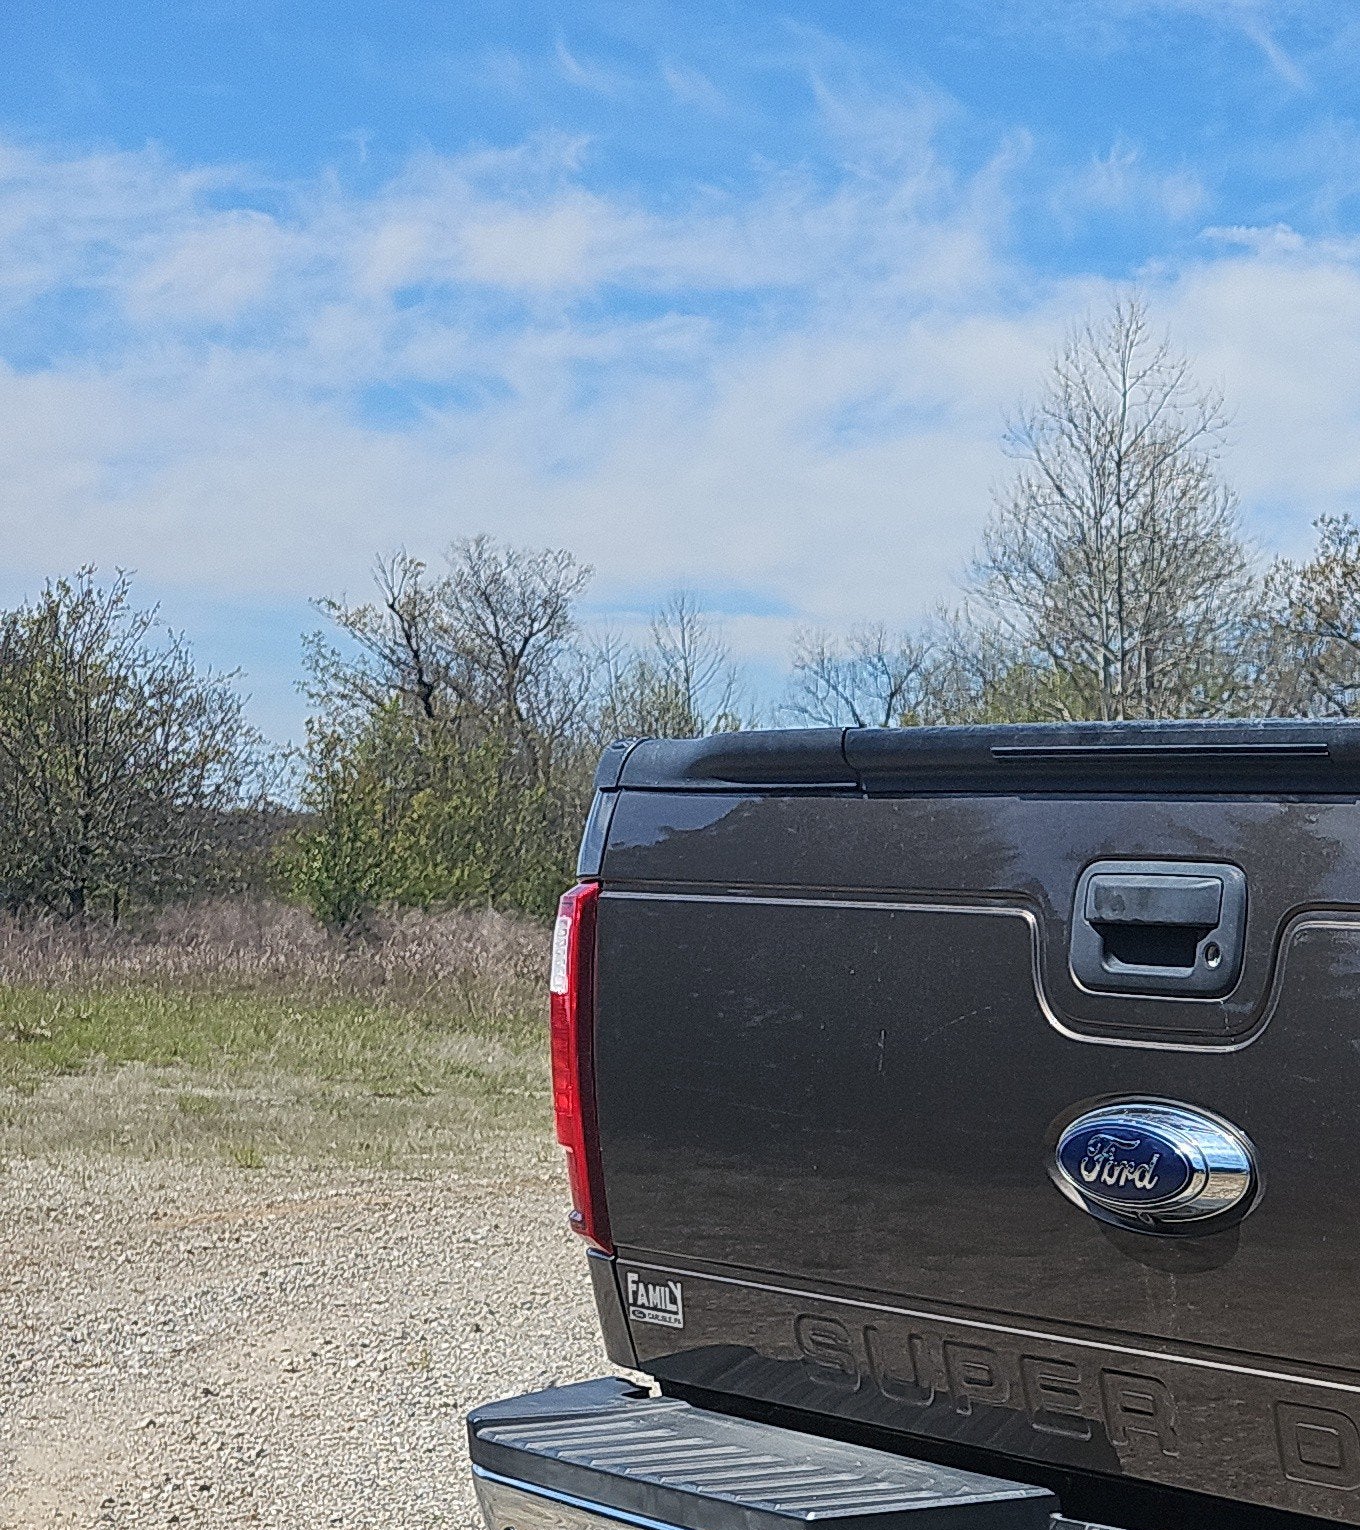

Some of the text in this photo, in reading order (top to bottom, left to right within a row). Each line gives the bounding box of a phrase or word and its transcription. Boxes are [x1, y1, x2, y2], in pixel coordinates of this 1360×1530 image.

[1079, 1133, 1160, 1191] Ford
[627, 1272, 682, 1314] FAMILY
[794, 1312, 1181, 1458] SUPER
